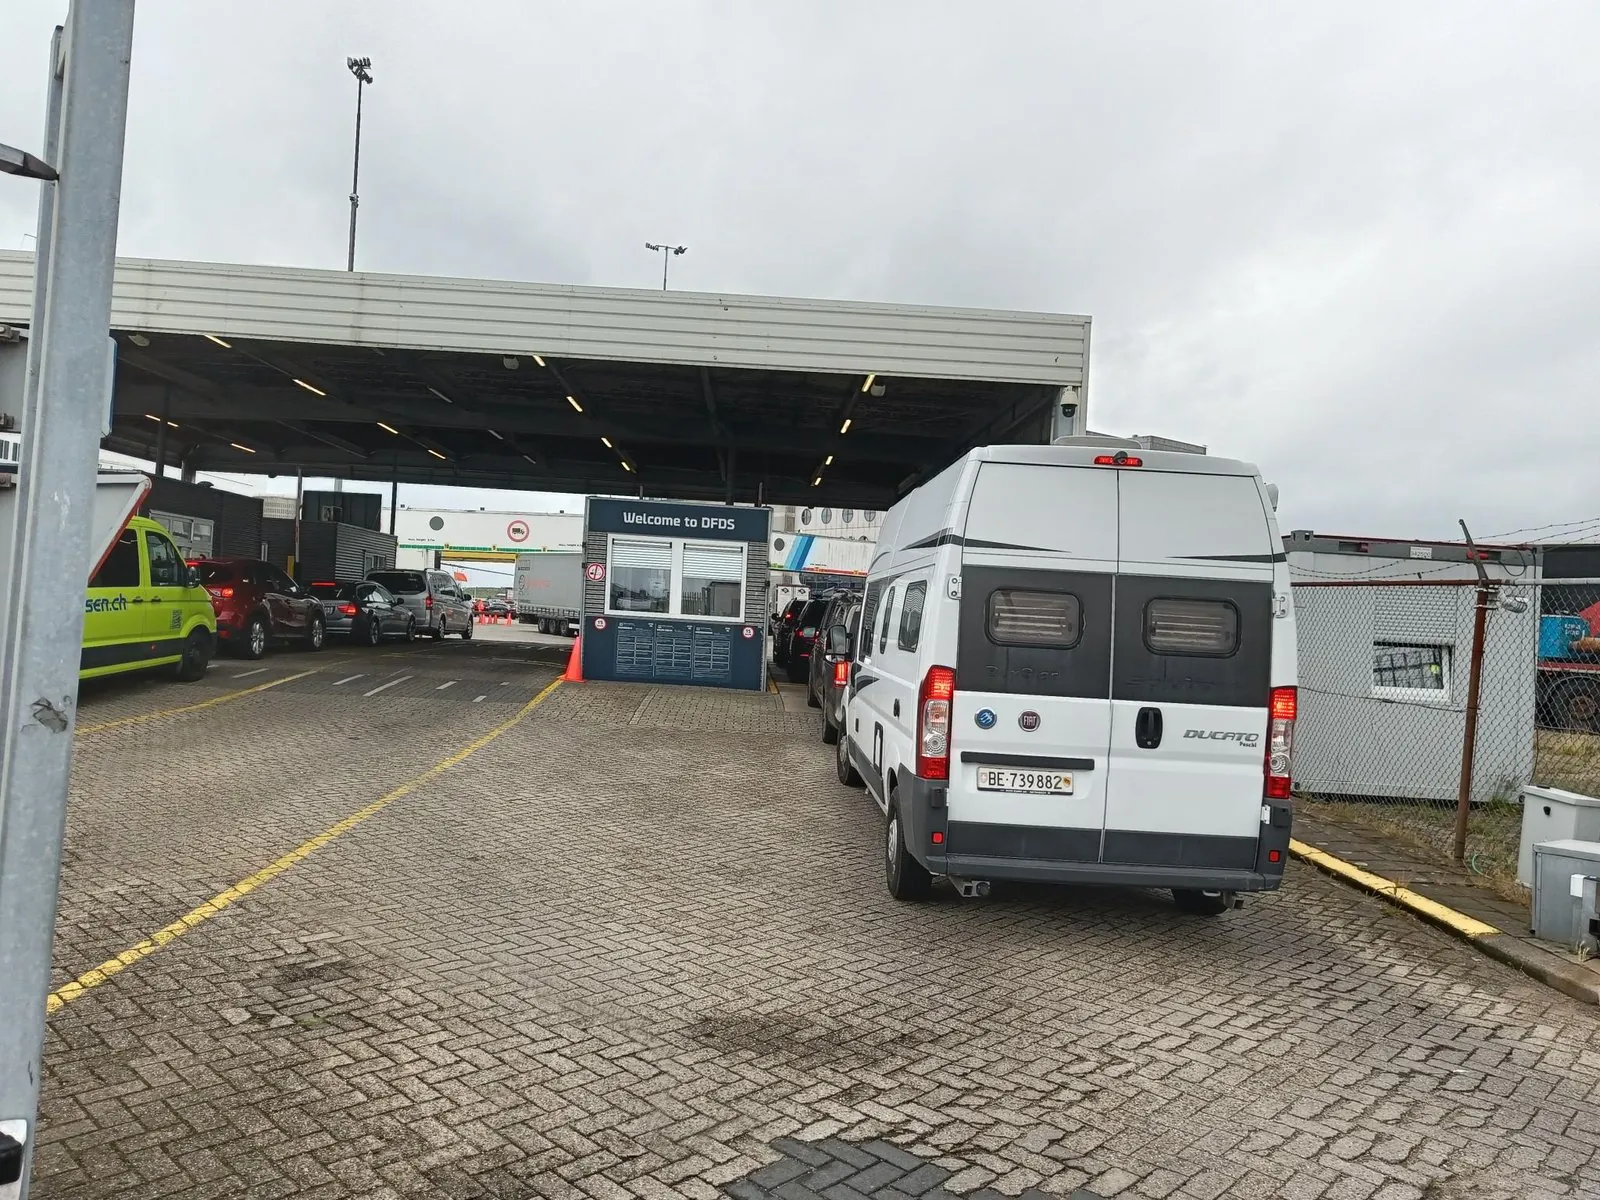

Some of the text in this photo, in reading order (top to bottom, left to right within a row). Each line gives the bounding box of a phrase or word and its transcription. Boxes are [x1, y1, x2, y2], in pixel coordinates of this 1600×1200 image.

[623, 512, 736, 530] Welcome to DFDS
[1023, 715, 1037, 727] FIAT
[1183, 729, 1260, 742] DUCATO
